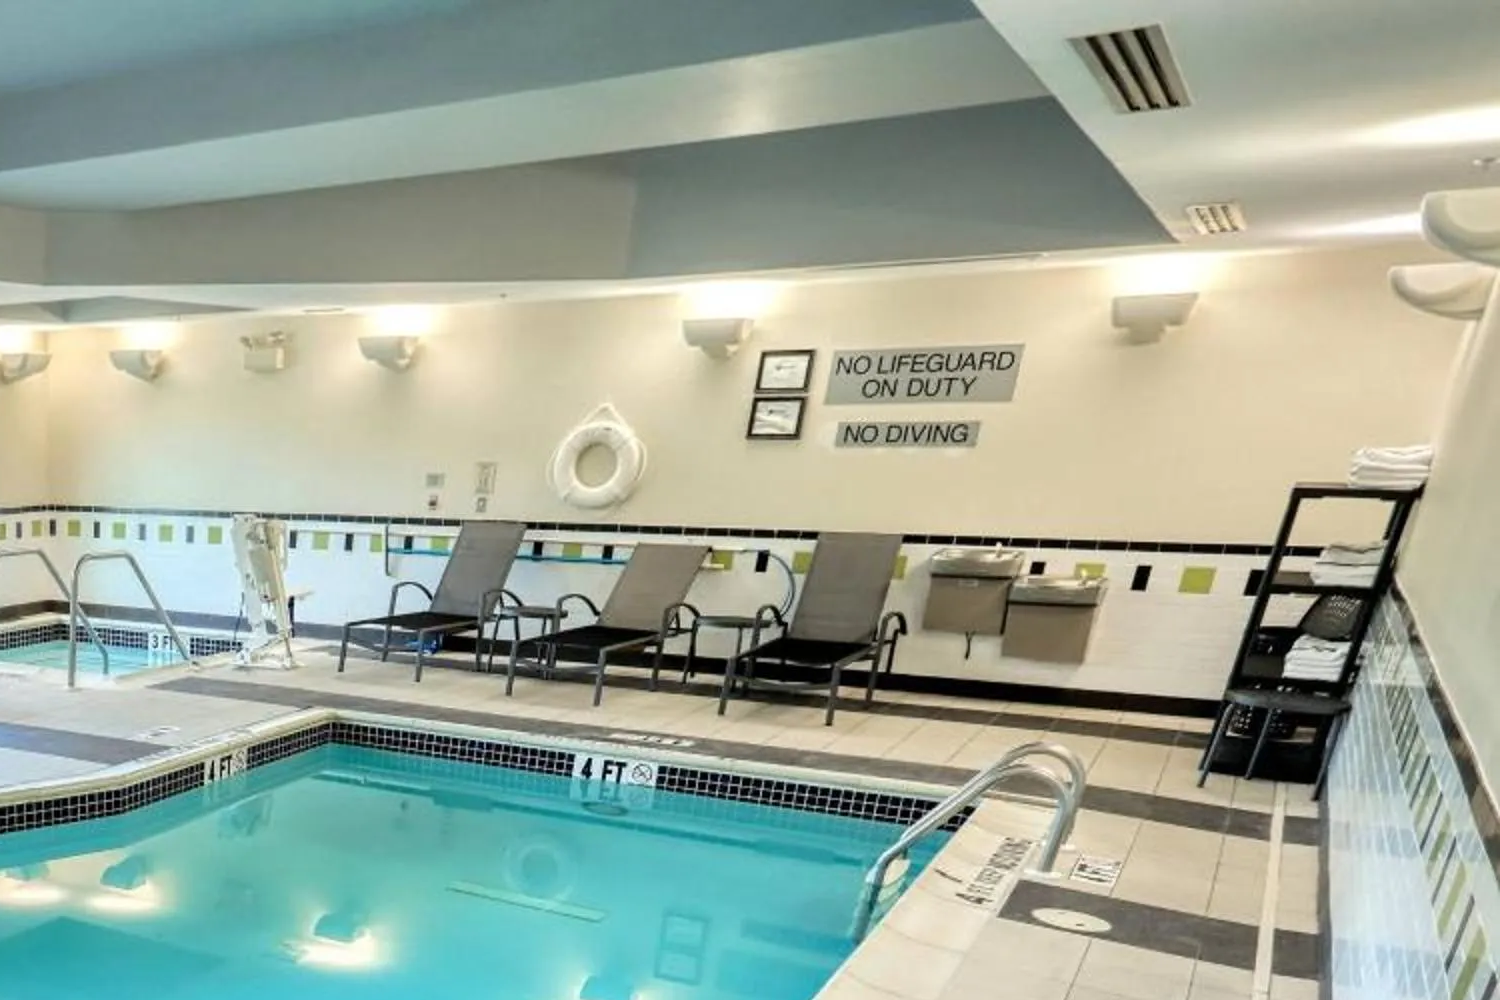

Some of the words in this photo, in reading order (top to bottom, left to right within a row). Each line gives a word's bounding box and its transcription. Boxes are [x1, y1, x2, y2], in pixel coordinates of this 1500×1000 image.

[835, 356, 871, 375] NO
[877, 351, 1015, 374] LIFEGUARD
[862, 379, 899, 398] ON
[907, 376, 978, 397] DUTY
[843, 425, 880, 443] NO
[886, 423, 969, 443] DIVING
[153, 634, 159, 648] 3
[208, 760, 214, 780] 4
[220, 755, 232, 777] FT
[581, 757, 593, 779] 4
[602, 760, 627, 784] FT
